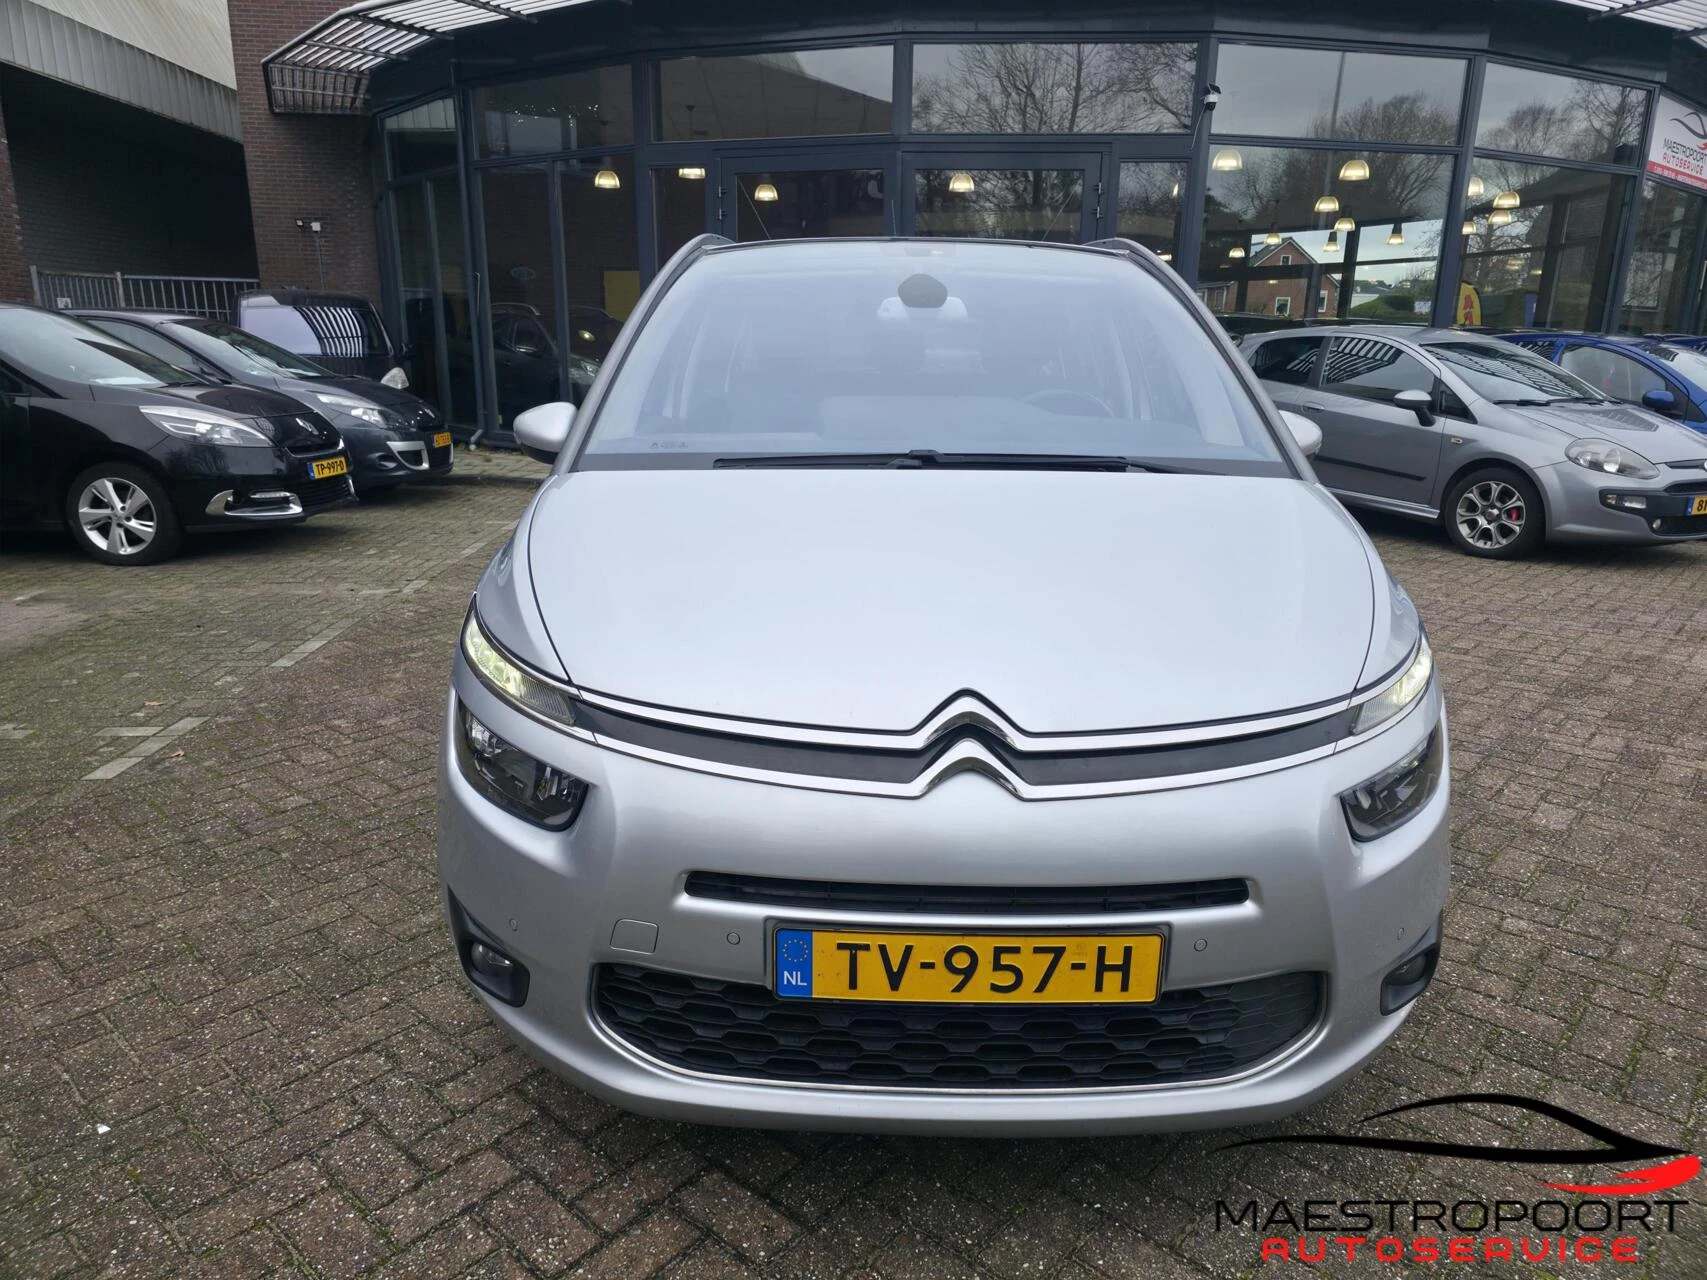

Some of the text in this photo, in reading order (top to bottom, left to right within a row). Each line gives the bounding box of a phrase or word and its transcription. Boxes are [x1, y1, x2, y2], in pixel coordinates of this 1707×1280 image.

[1662, 152, 1704, 176] AUTOSERVICE
[783, 970, 807, 987] NL
[836, 941, 1133, 993] TV-957-H
